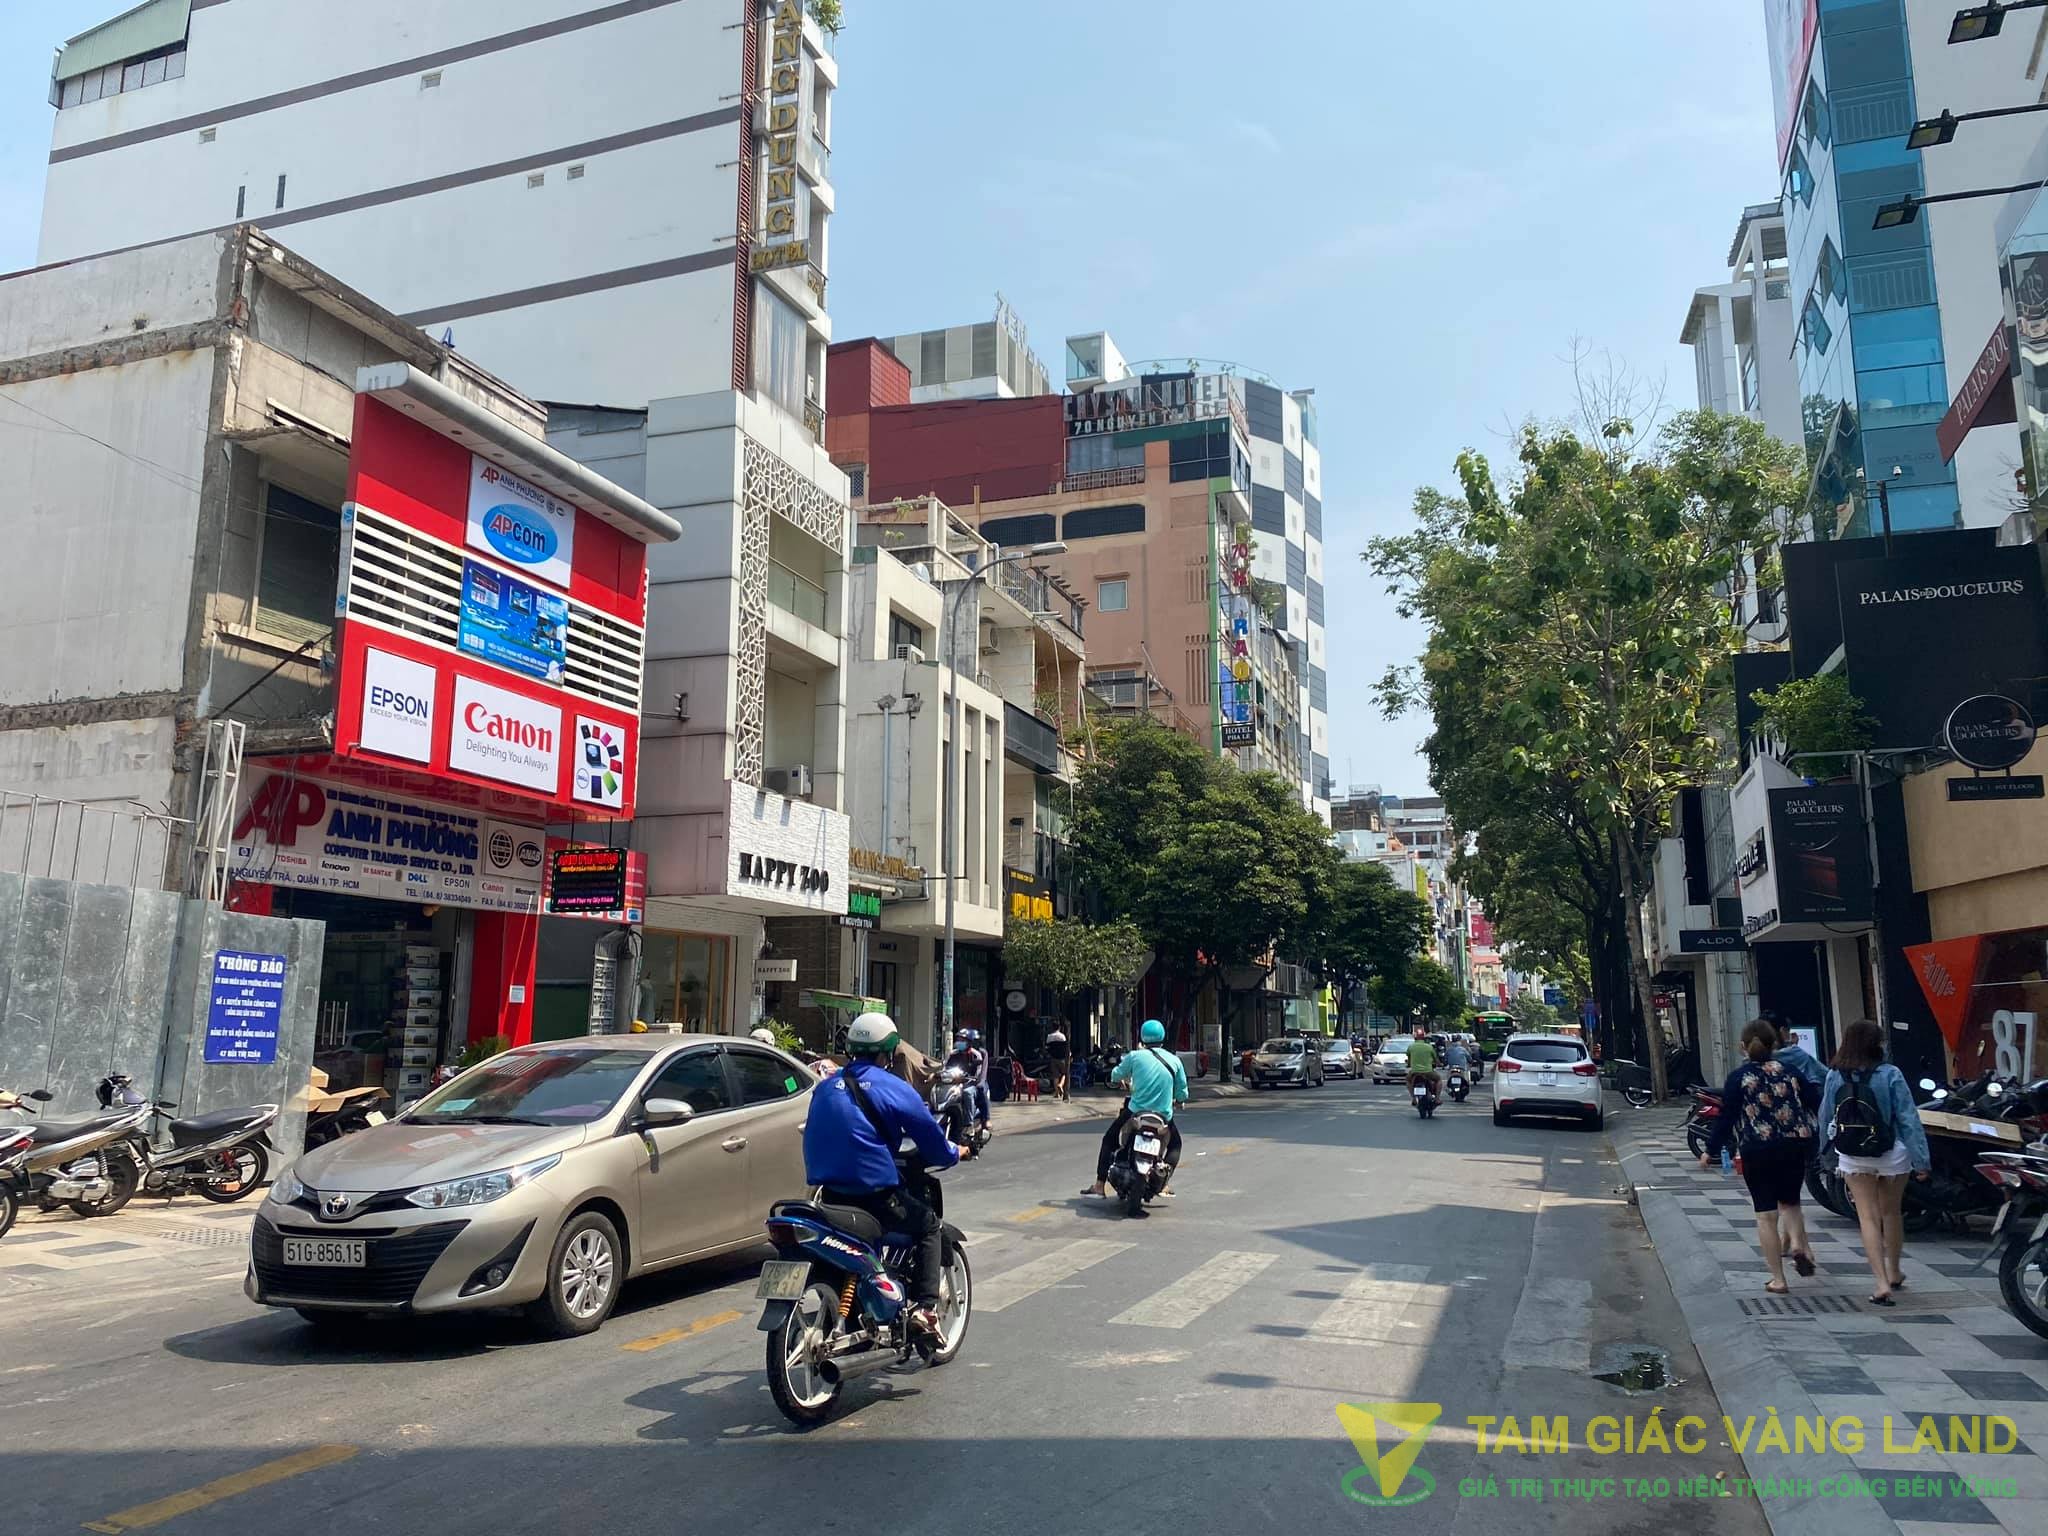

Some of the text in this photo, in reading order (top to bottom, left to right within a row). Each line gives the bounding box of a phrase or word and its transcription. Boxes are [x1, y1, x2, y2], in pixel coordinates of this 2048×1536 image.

[751, 243, 808, 270] HOTEL
[481, 467, 500, 484] AP
[1232, 544, 1247, 559] 70
[1860, 588, 1921, 605] PALAIS
[1924, 579, 2024, 600] DOUCEURS
[371, 686, 428, 718] EPSON
[464, 702, 552, 753] Canon
[1225, 726, 1252, 735] HOTEL
[466, 739, 549, 771] Delighting You Always
[231, 774, 326, 846] AP
[326, 808, 382, 844] ANH
[276, 854, 307, 865] TOSHIBA
[321, 861, 350, 872] lenovo
[324, 843, 369, 860] COMPUTER
[371, 850, 408, 866] TRADING
[410, 856, 439, 871] SERVICE
[444, 877, 470, 889] EPSON
[739, 852, 829, 892] HAPPY ZOO
[342, 880, 360, 890] HCM
[481, 881, 504, 893] Canon
[1697, 937, 1734, 945] ALDO
[219, 955, 283, 974] THÔNG BÁO
[1992, 1010, 2037, 1085] 87
[288, 1242, 362, 1265] 51G-856.15
